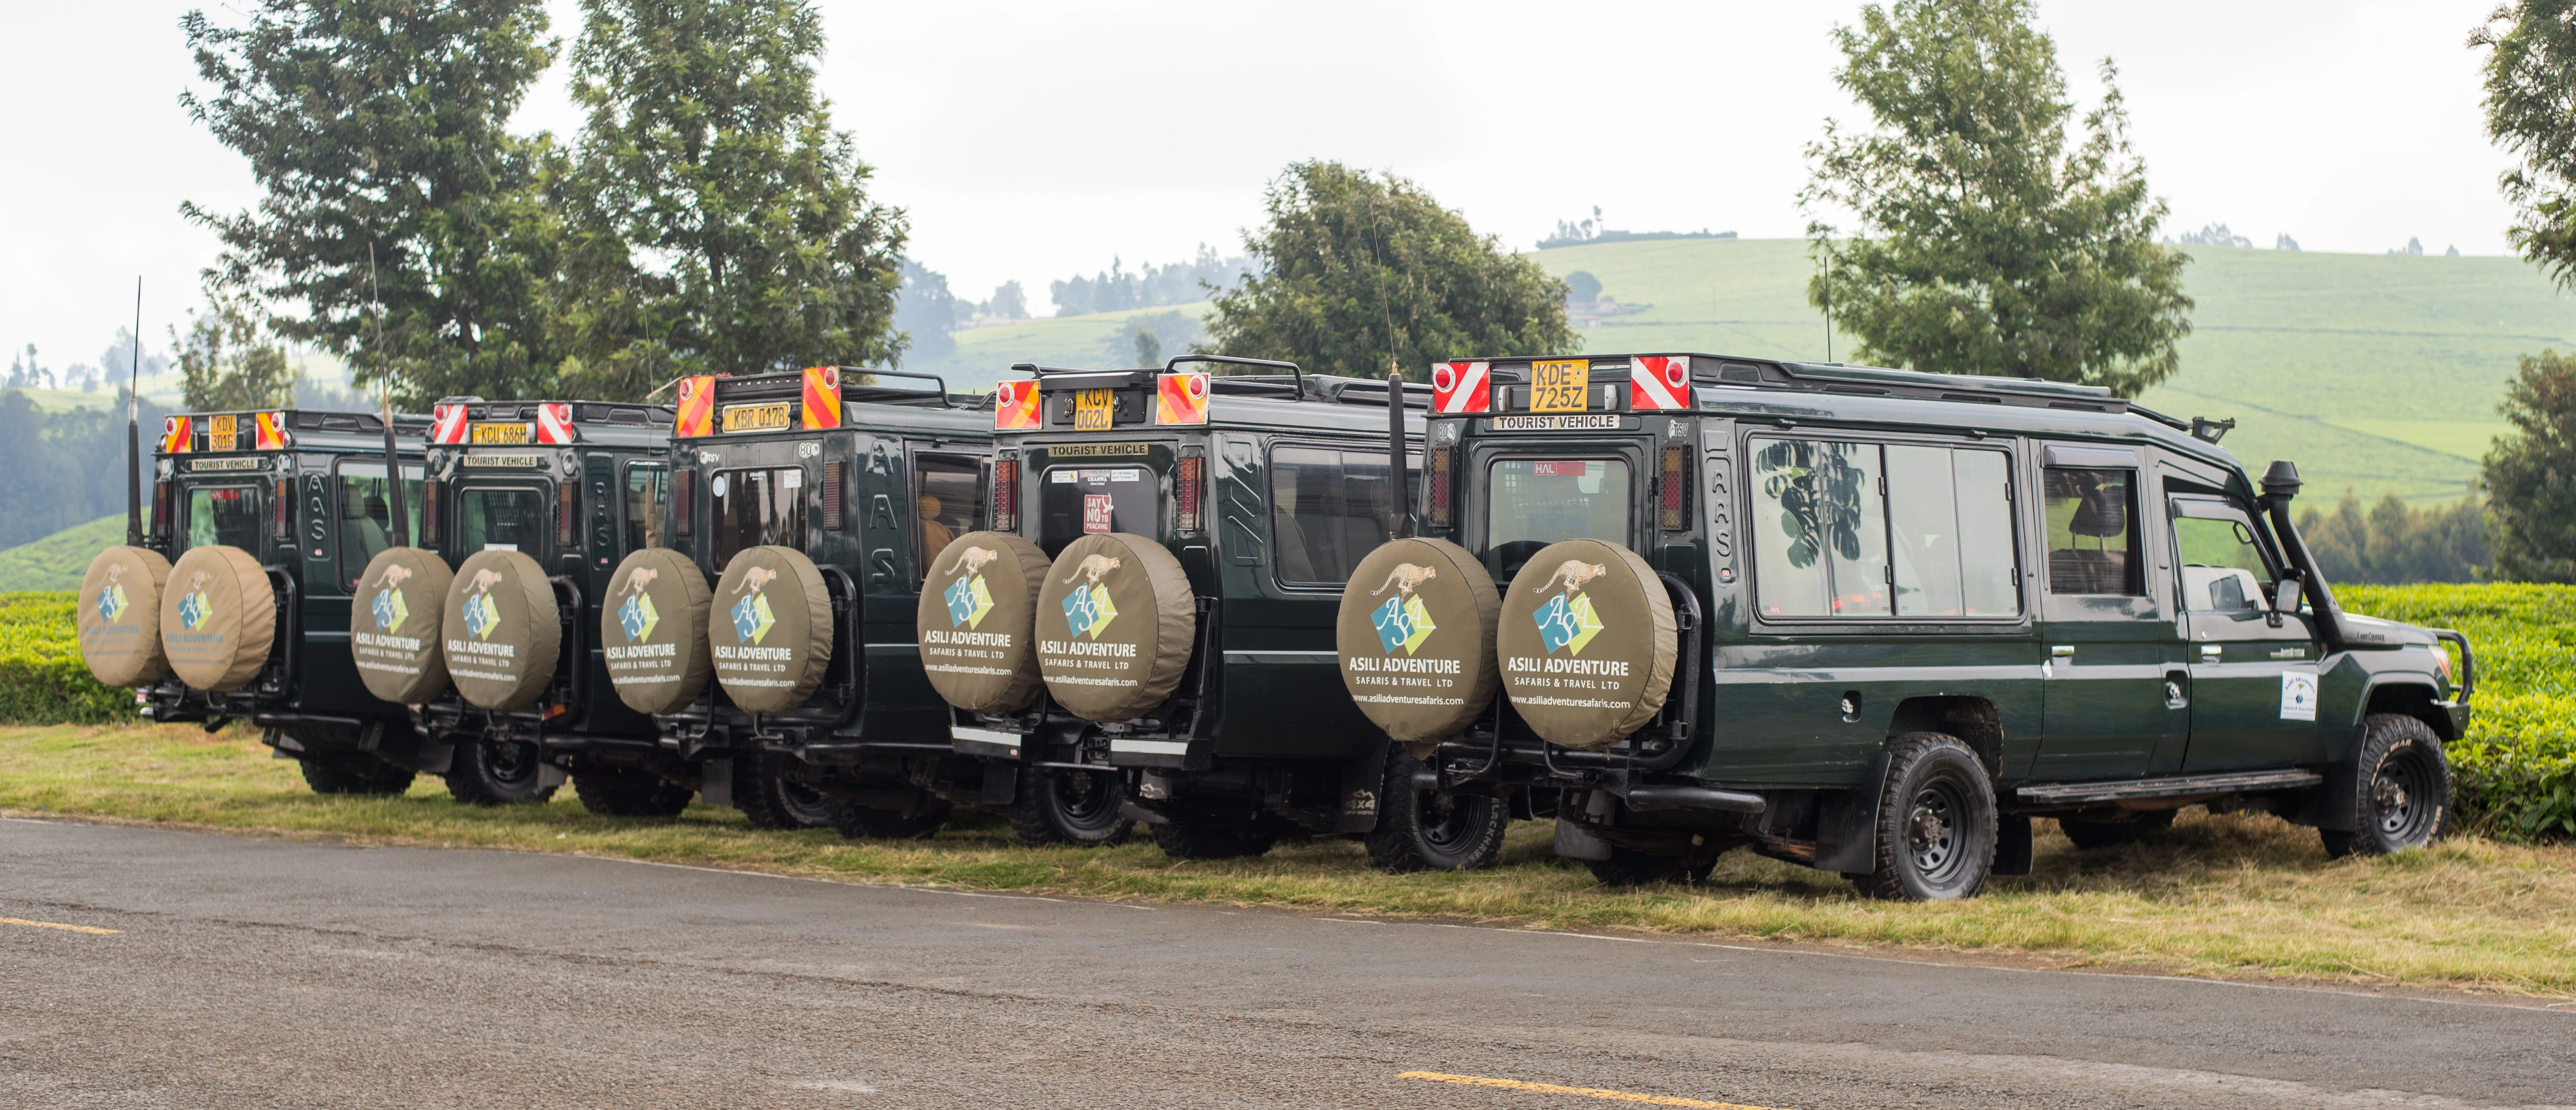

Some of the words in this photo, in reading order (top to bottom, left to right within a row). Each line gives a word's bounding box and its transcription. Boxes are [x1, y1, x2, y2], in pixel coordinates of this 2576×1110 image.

[1536, 364, 1571, 386] KDE
[1085, 388, 1108, 406] KCV
[1535, 386, 1582, 408] 725Z
[216, 414, 233, 432] KDV
[734, 409, 754, 429] KBR
[758, 406, 785, 427] 017B
[1077, 408, 1108, 429] 002L
[1499, 416, 1556, 429] TOURIST
[1559, 415, 1614, 428] VEHICLE
[482, 426, 499, 444] KCU
[503, 426, 526, 444] 686H
[1438, 423, 1448, 439] 80
[1674, 423, 1689, 437] TSV
[212, 433, 234, 449] 301G
[800, 443, 812, 457] 80
[1052, 446, 1097, 456] TOURIST
[1100, 444, 1146, 455] VEHICLE
[194, 461, 224, 470] TOURIST
[225, 459, 255, 469] VEHICLE
[467, 456, 499, 465] TOURIST
[502, 456, 534, 465] VEHICLE
[707, 453, 720, 463] TSV
[1536, 464, 1555, 474] HAL
[1088, 497, 1101, 508] SAY
[1087, 508, 1101, 522] NO
[1101, 514, 1108, 523] TO
[165, 633, 182, 643] ASILI
[183, 634, 224, 644] ADVENTURE
[356, 632, 374, 646] ASILI
[376, 634, 421, 651] ADVENTURE
[925, 630, 949, 644] ASILI
[951, 632, 1011, 647] ADVENTURE
[359, 646, 379, 657] SAFARIS
[386, 650, 403, 660] TRAVEL
[405, 652, 415, 661] LTD
[448, 639, 466, 653] ASILI
[468, 641, 515, 657] ADVENTURE
[607, 646, 625, 660] ASILI
[627, 643, 676, 658] ADVENTURE
[715, 646, 736, 659] ASILI
[738, 647, 791, 661] ADVENTURE
[929, 647, 956, 657] SAFARIS
[957, 649, 963, 657] &
[964, 650, 988, 659] TRAVEL
[991, 651, 1004, 659] LTD
[1040, 640, 1066, 655] ASILI
[1069, 642, 1137, 657] ADVENTURE
[452, 654, 472, 664] SAFARIS
[479, 657, 497, 667] TRAVEL
[499, 659, 510, 668] LTD
[611, 662, 632, 670] SAFARIS
[633, 662, 638, 670] &
[639, 661, 658, 669] TRAVEL
[661, 660, 672, 669] LTD
[719, 662, 742, 671] SAFARIS
[743, 663, 748, 671] &
[749, 663, 771, 672] TRAVEL
[773, 664, 786, 672] LTD
[1045, 658, 1074, 668] SAFARIS
[1076, 659, 1081, 669] &
[1084, 660, 1111, 670] TRAVEL
[1115, 661, 1129, 670] LTD
[1349, 657, 1380, 671] ASILI
[1382, 658, 1461, 674] ADVENTURE
[1508, 657, 1541, 672] ASILI
[1544, 658, 1629, 676] ADVENTURE
[925, 663, 1012, 676] www.asiliadventuresafaris.com
[1043, 675, 1138, 688] www.asiliadventuresafaris.com
[1356, 676, 1389, 686] SAFARIS
[1392, 677, 1398, 686] &
[1401, 678, 1432, 687] TRAVEL
[1437, 679, 1453, 688] LTD
[1514, 677, 1551, 687] SAFARIS
[1554, 678, 1561, 688] &
[1563, 679, 1596, 689] TRAVEL
[1602, 680, 1620, 690] LTD
[1353, 693, 1464, 706] www.asiliadventuresafaris.com
[1511, 695, 1631, 709] www.asiliadventuresafaris.com
